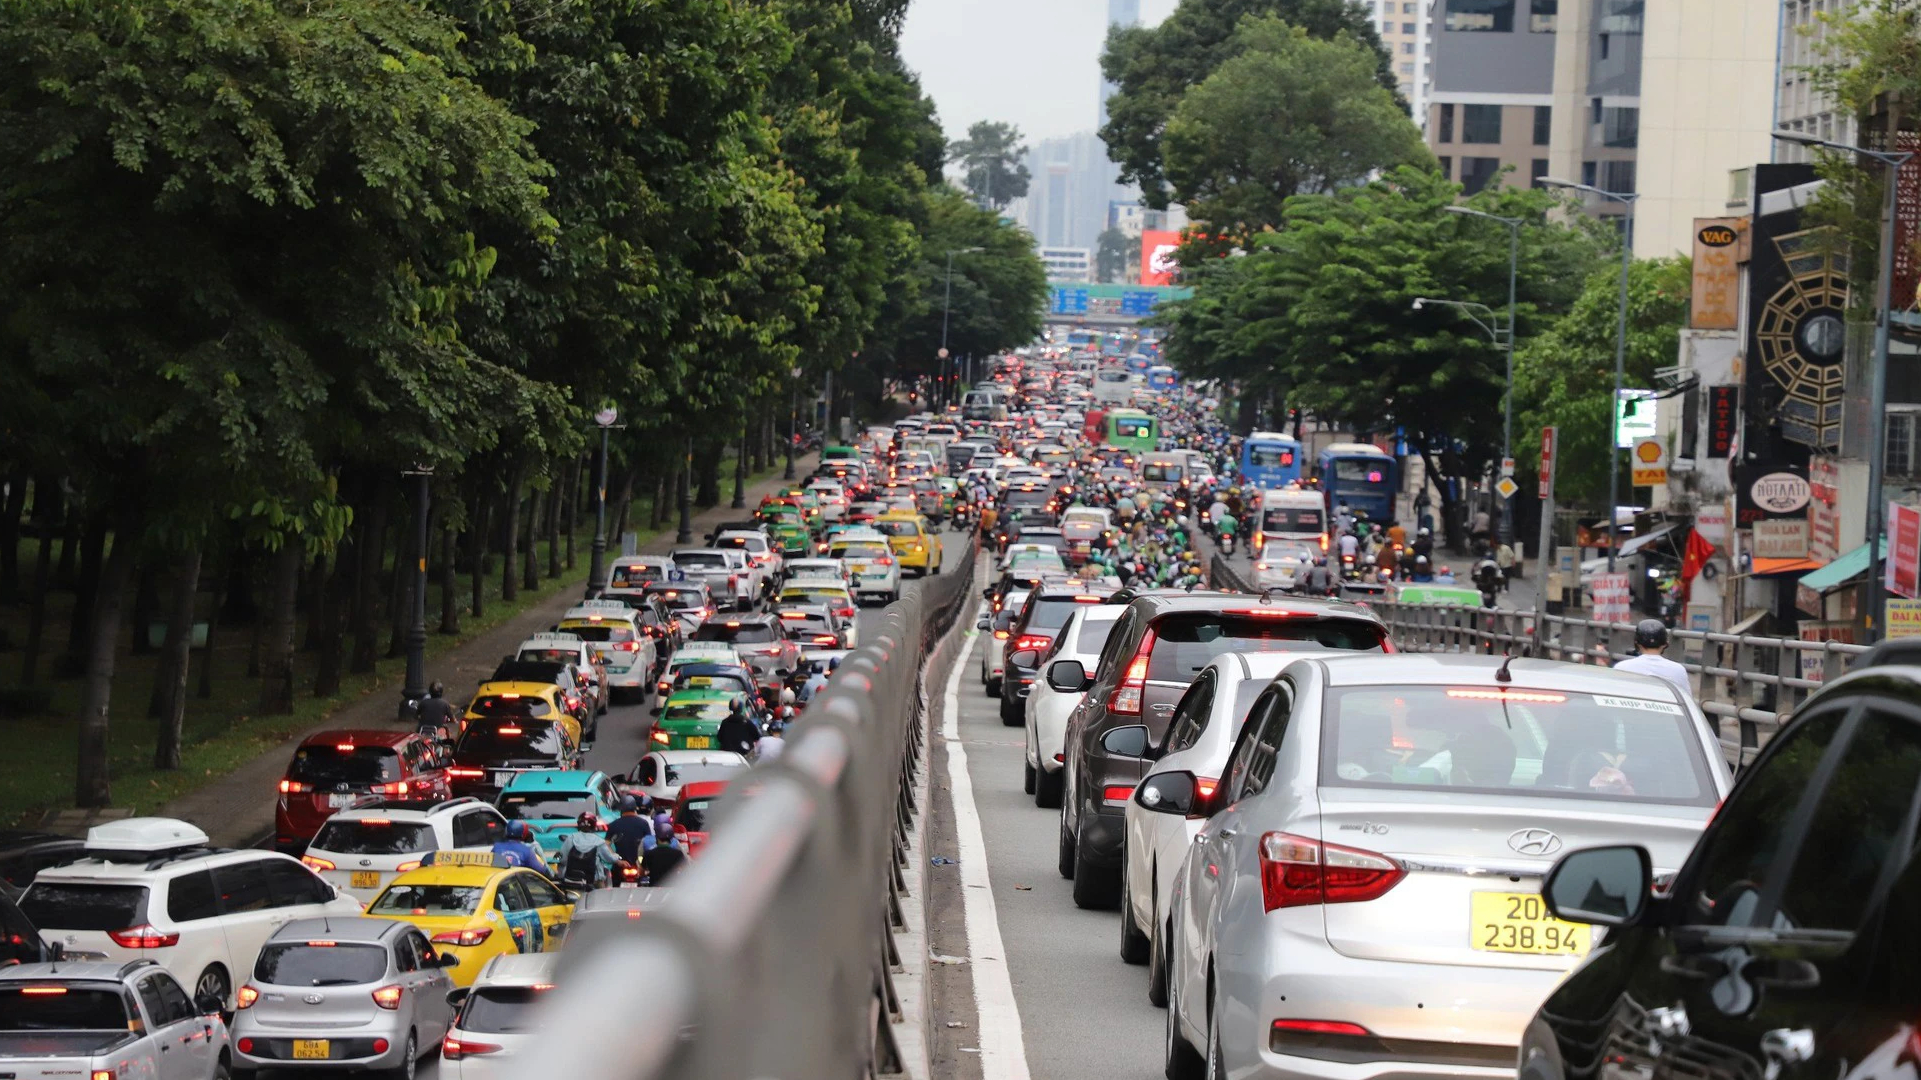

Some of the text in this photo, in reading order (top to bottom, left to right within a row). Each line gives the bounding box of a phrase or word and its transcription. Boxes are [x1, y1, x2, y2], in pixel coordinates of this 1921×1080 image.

[1702, 231, 1733, 243] VAG
[1715, 388, 1730, 451] TATTOO
[439, 854, 490, 863] 38 111 111
[1484, 924, 1577, 950] 238.94
